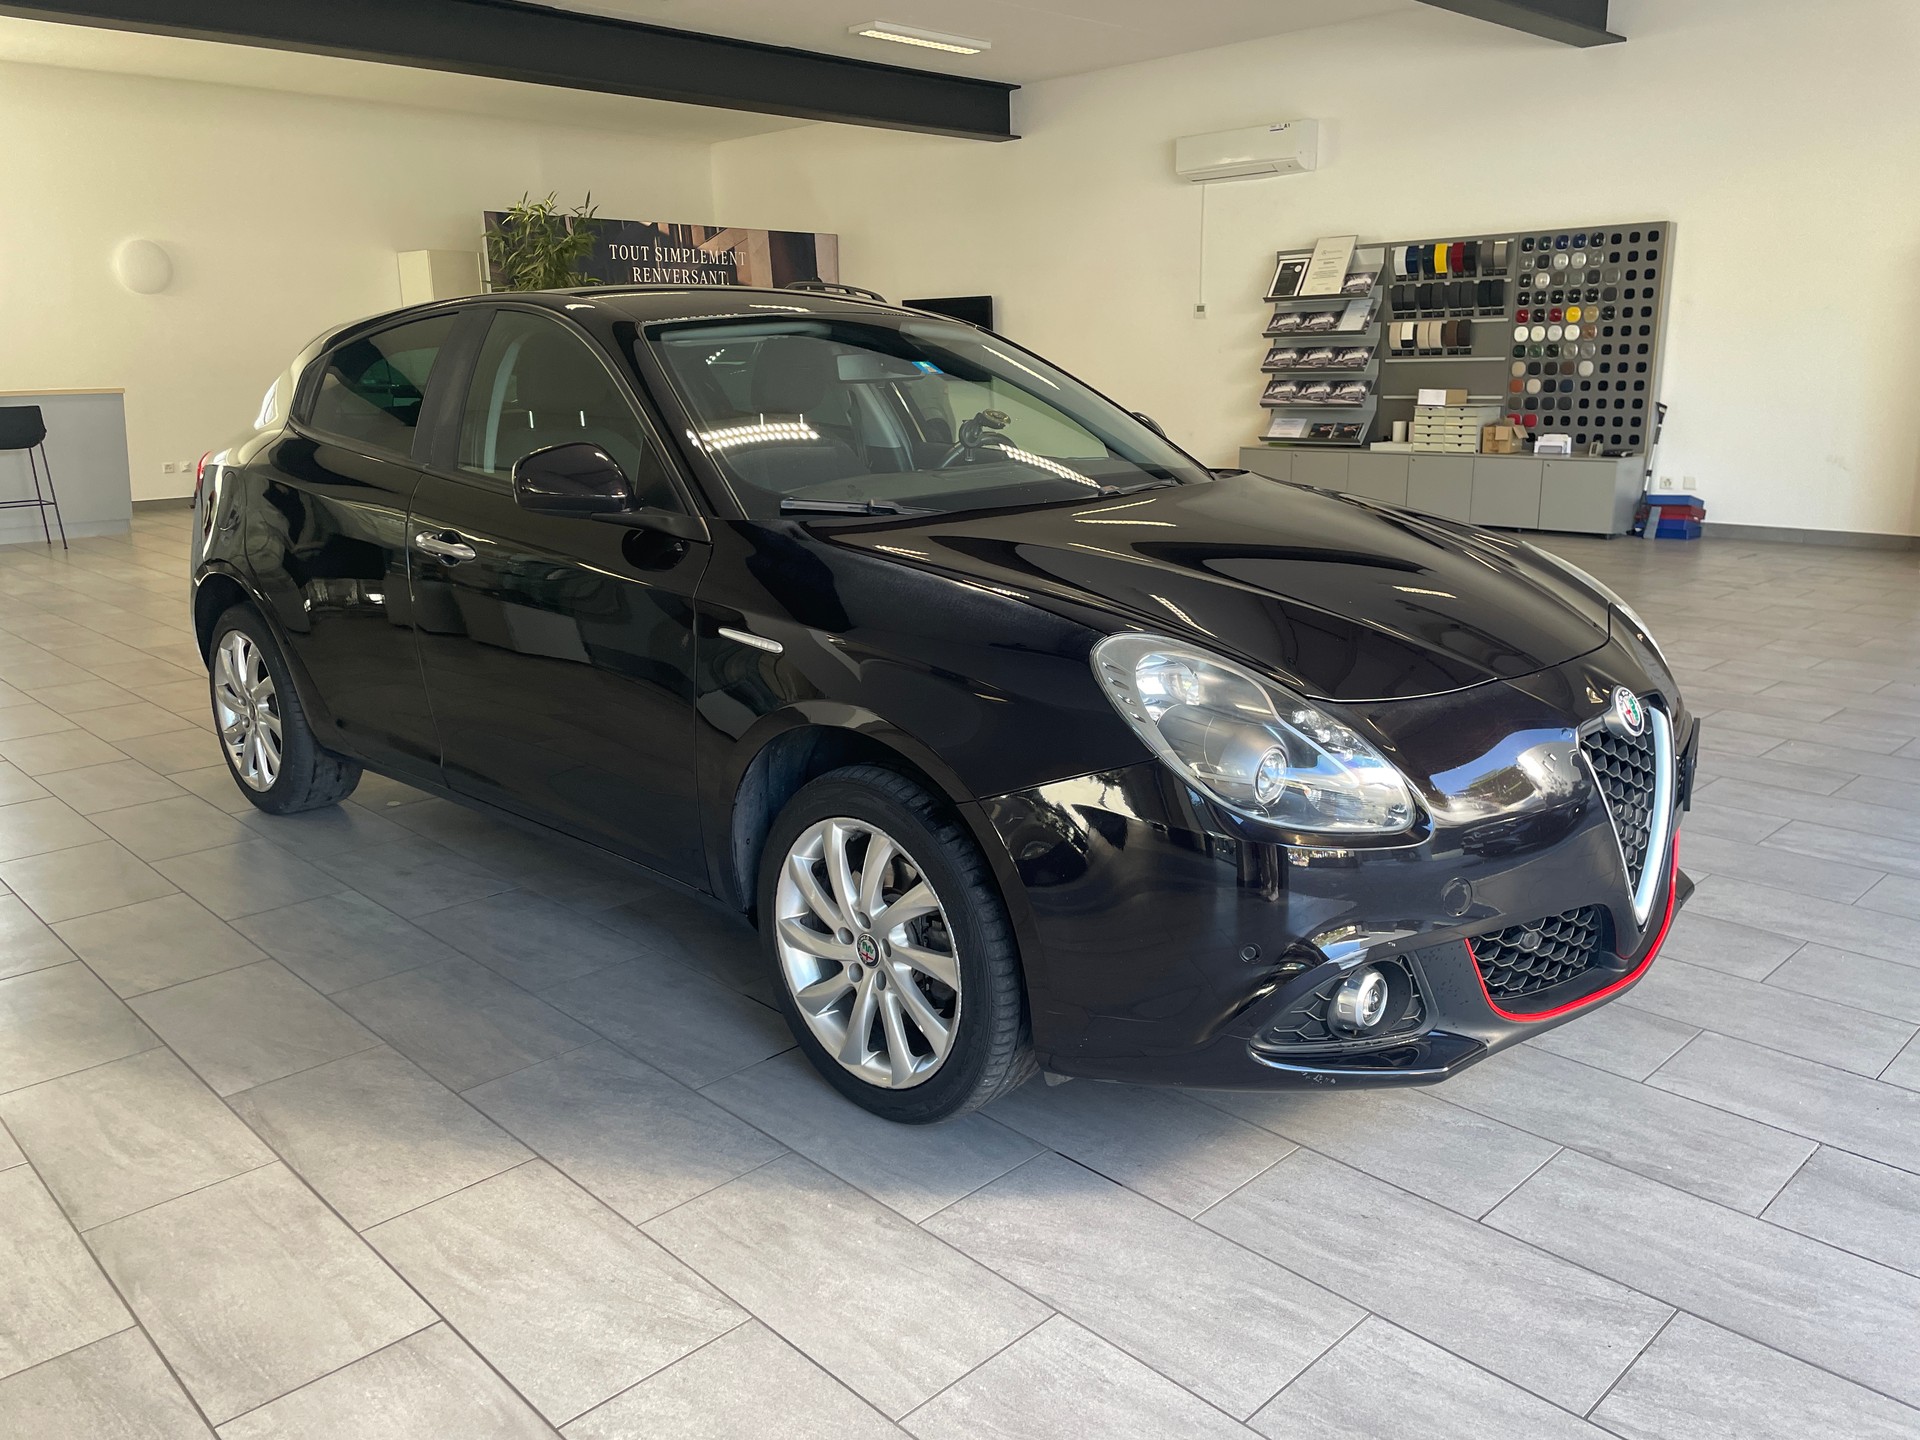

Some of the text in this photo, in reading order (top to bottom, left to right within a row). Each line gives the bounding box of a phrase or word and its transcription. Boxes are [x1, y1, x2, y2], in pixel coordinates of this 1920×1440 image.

[608, 244, 747, 266] TOUT SIMPLEMENT
[632, 266, 730, 286] RENVERSANT.
